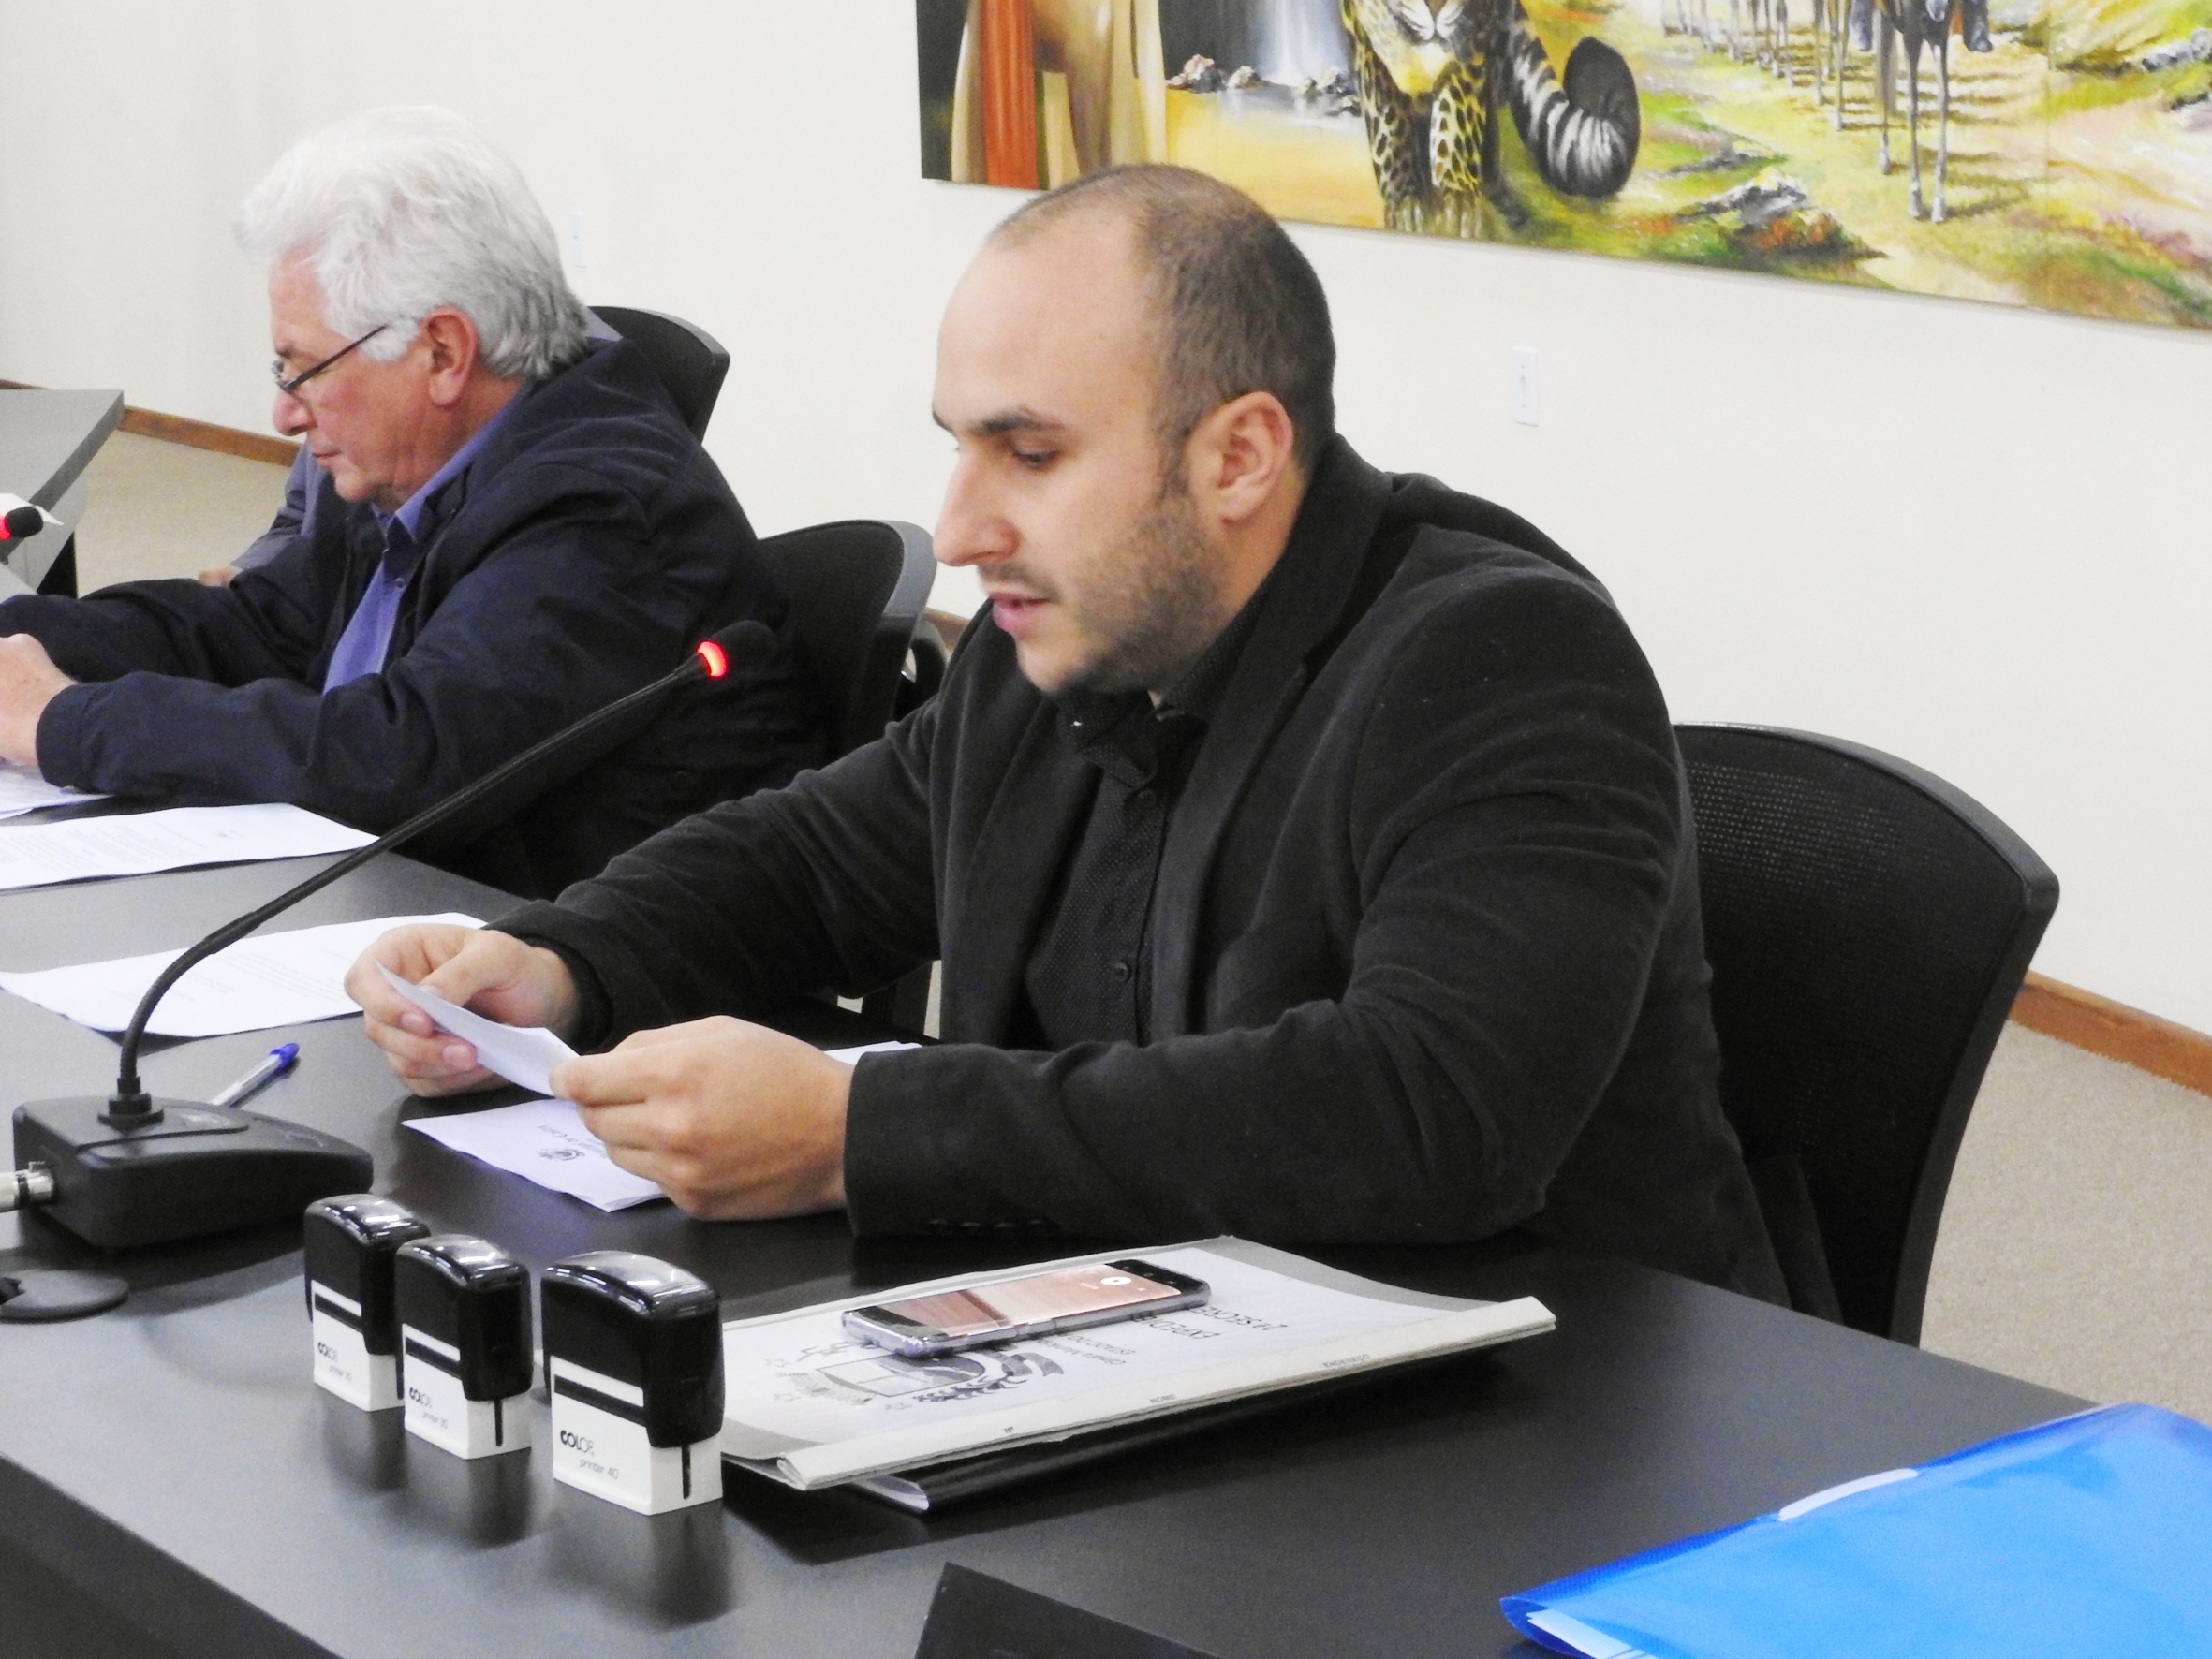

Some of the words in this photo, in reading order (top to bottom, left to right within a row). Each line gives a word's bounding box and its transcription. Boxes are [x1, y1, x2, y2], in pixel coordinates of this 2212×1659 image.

[1184, 1306, 1262, 1326] SECRE
[580, 1459, 605, 1475] printer
[607, 1467, 620, 1480] 40
